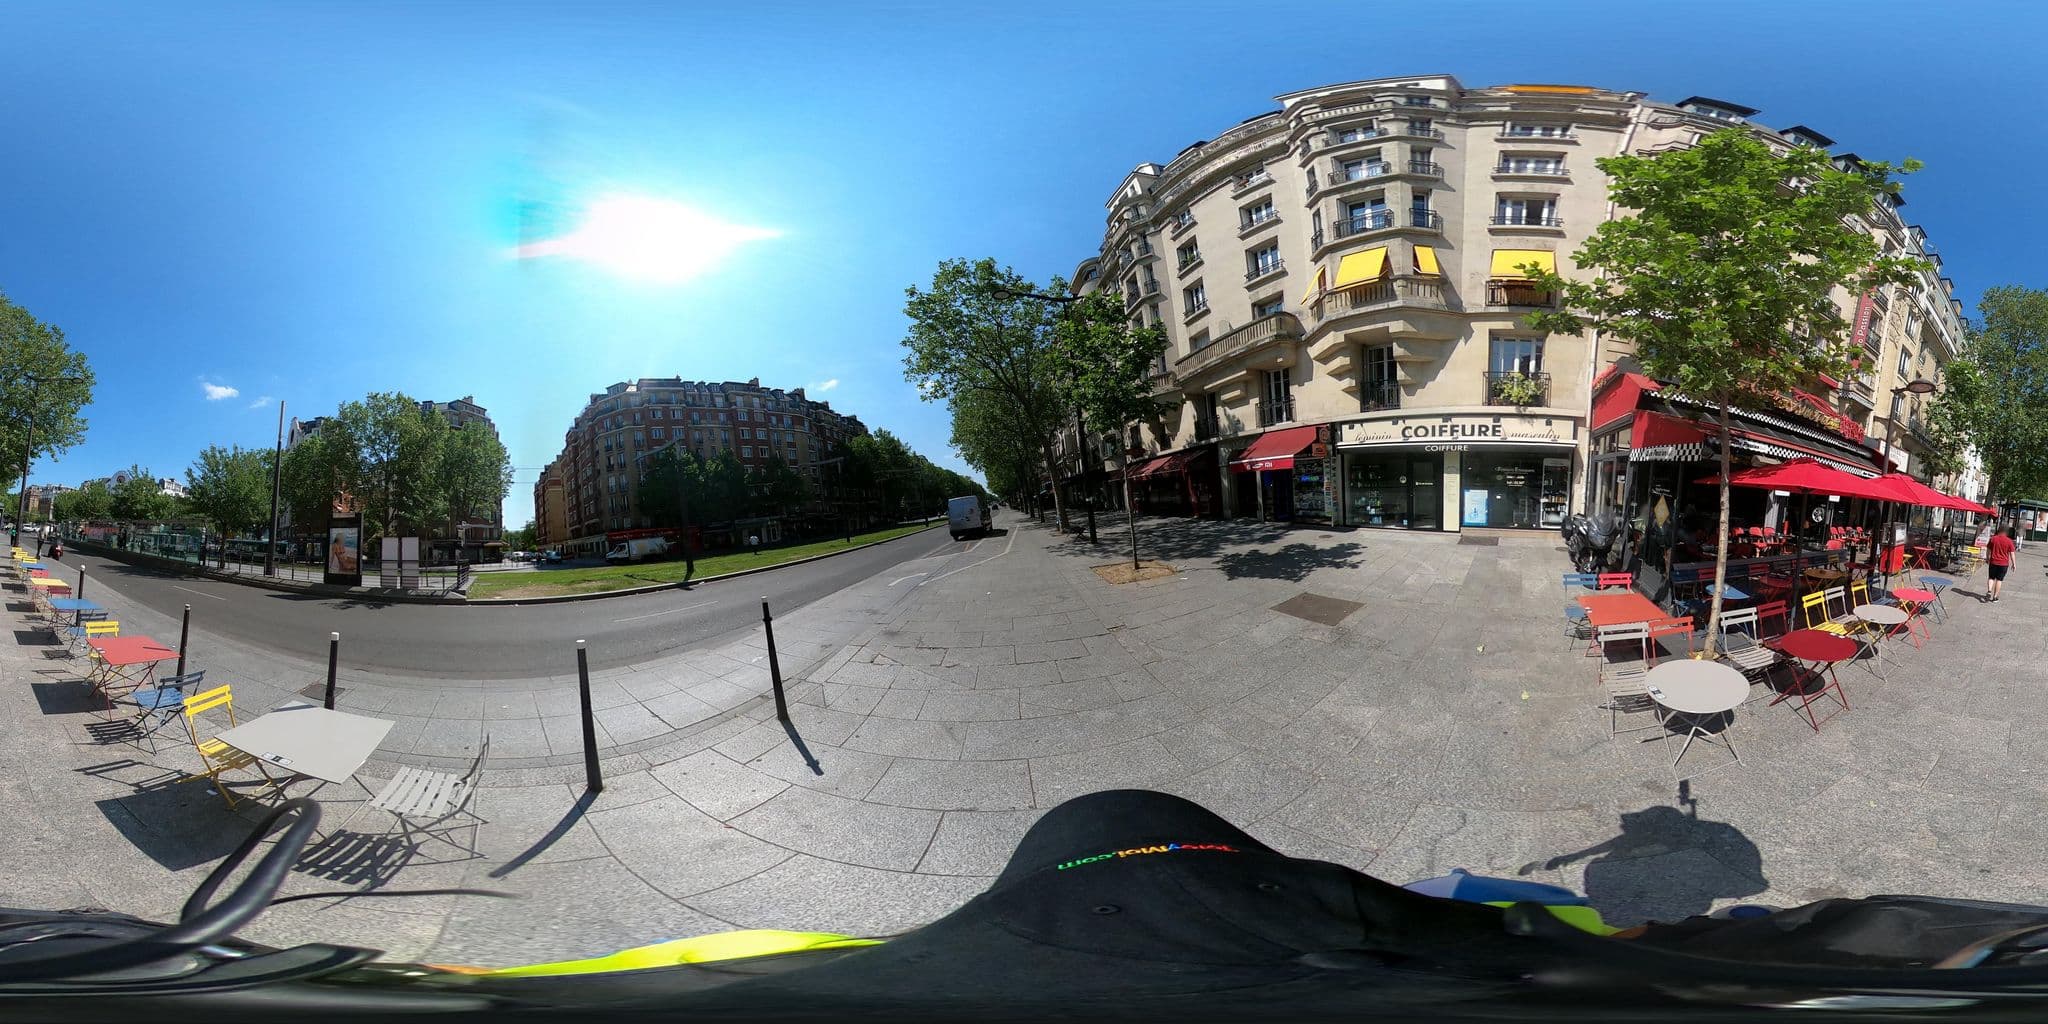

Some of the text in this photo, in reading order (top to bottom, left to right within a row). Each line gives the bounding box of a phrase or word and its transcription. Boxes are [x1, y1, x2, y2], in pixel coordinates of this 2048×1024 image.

[1857, 305, 1871, 336] Passion
[1401, 424, 1502, 438] COIFFURE
[1424, 444, 1470, 452] COIFFURE
